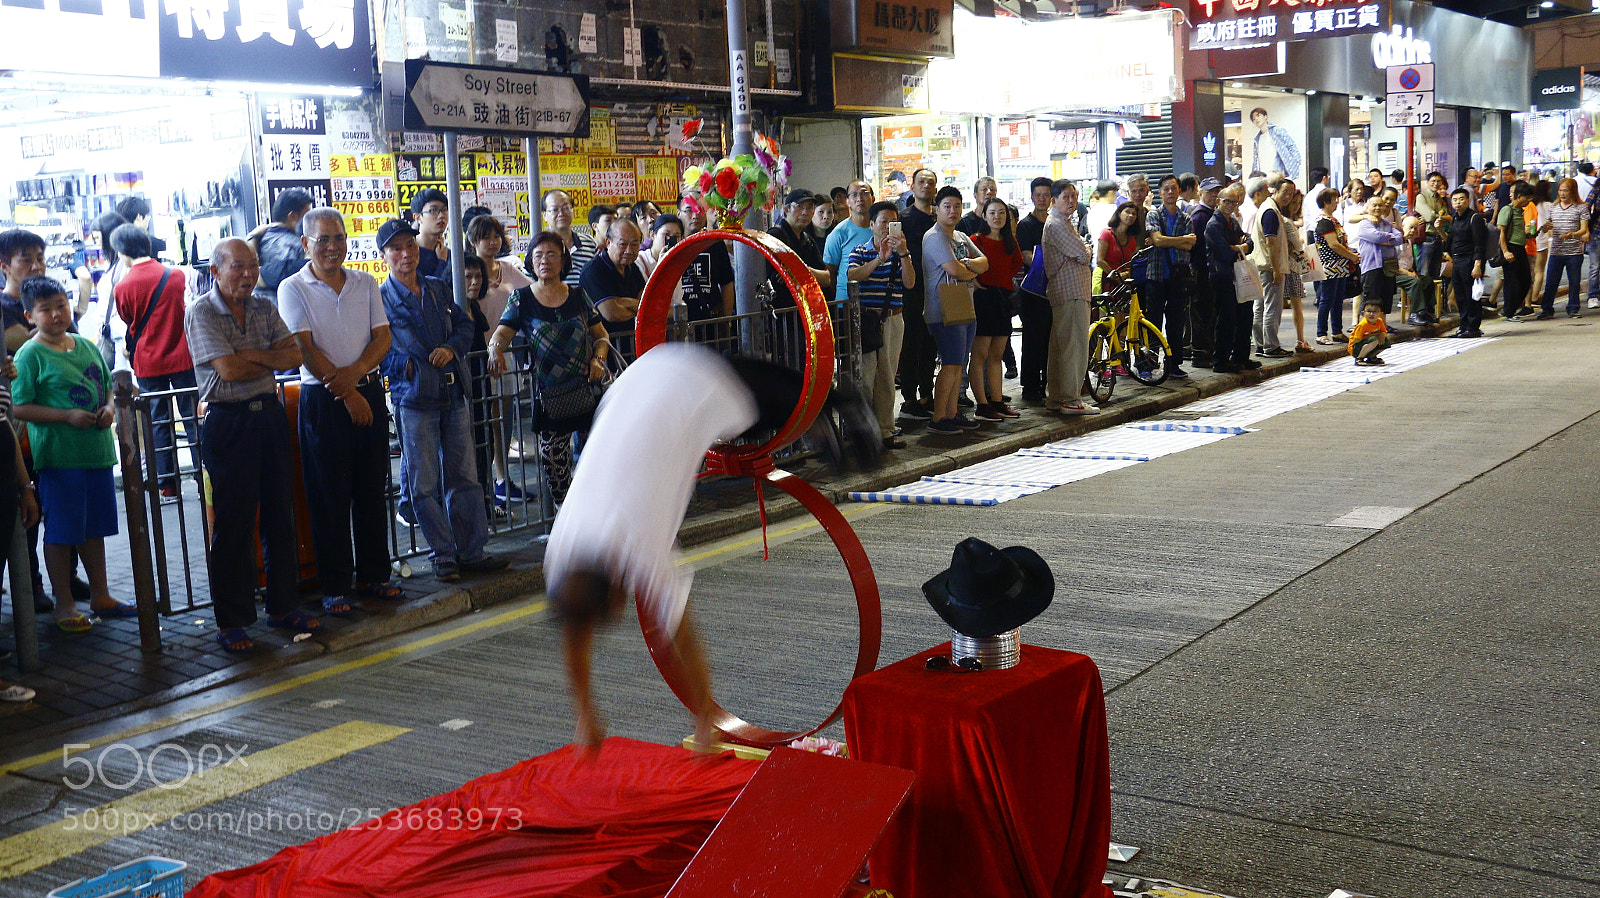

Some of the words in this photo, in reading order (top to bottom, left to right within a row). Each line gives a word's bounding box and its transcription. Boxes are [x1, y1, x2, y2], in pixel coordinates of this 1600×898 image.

[1197, 15, 1277, 42] 政府註冊
[1292, 4, 1379, 34] 優質正貨
[464, 74, 490, 95] Soy
[496, 77, 537, 95] Street
[1541, 85, 1575, 95] adidas
[1416, 94, 1424, 105] 7
[266, 98, 318, 130] 手機配件
[1416, 112, 1431, 124] 12
[270, 142, 322, 172] 批發價
[334, 191, 361, 200] 9279
